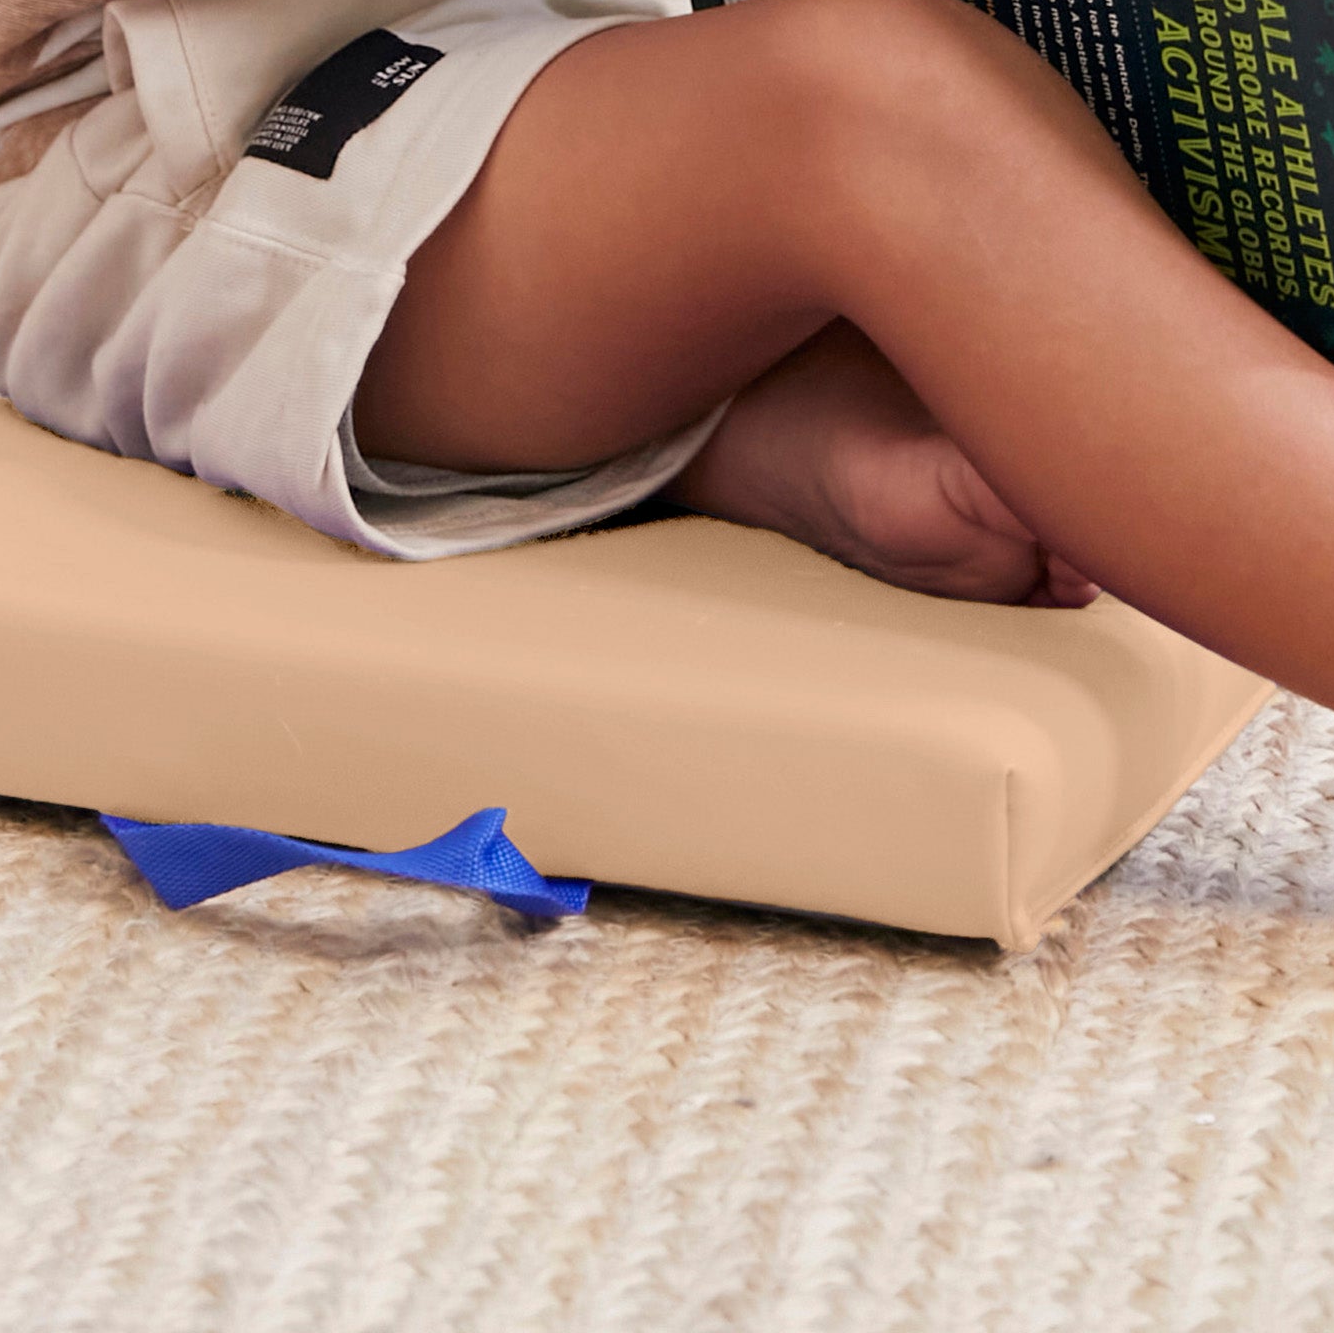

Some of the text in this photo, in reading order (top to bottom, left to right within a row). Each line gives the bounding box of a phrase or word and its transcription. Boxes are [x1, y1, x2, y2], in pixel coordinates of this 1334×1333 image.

[1030, 3, 1044, 28] the
[1069, 11, 1081, 23] A
[1087, 8, 1102, 37] lost
[1106, 12, 1121, 38] the
[1046, 6, 1065, 47] many
[1058, 50, 1072, 82] mor
[1072, 25, 1093, 84] football
[1094, 42, 1108, 68] her
[376, 55, 412, 80] LOW
[392, 60, 427, 86] SUN
[1111, 42, 1134, 112] Kentucky
[1099, 71, 1113, 101] arm
[1106, 106, 1118, 121] in
[1126, 116, 1145, 165] Derby.
[1215, 118, 1247, 183] THE
[1228, 28, 1271, 140] BROKE
[1250, 144, 1301, 306] RECORDS,
[1227, 186, 1268, 289] GLOBE
